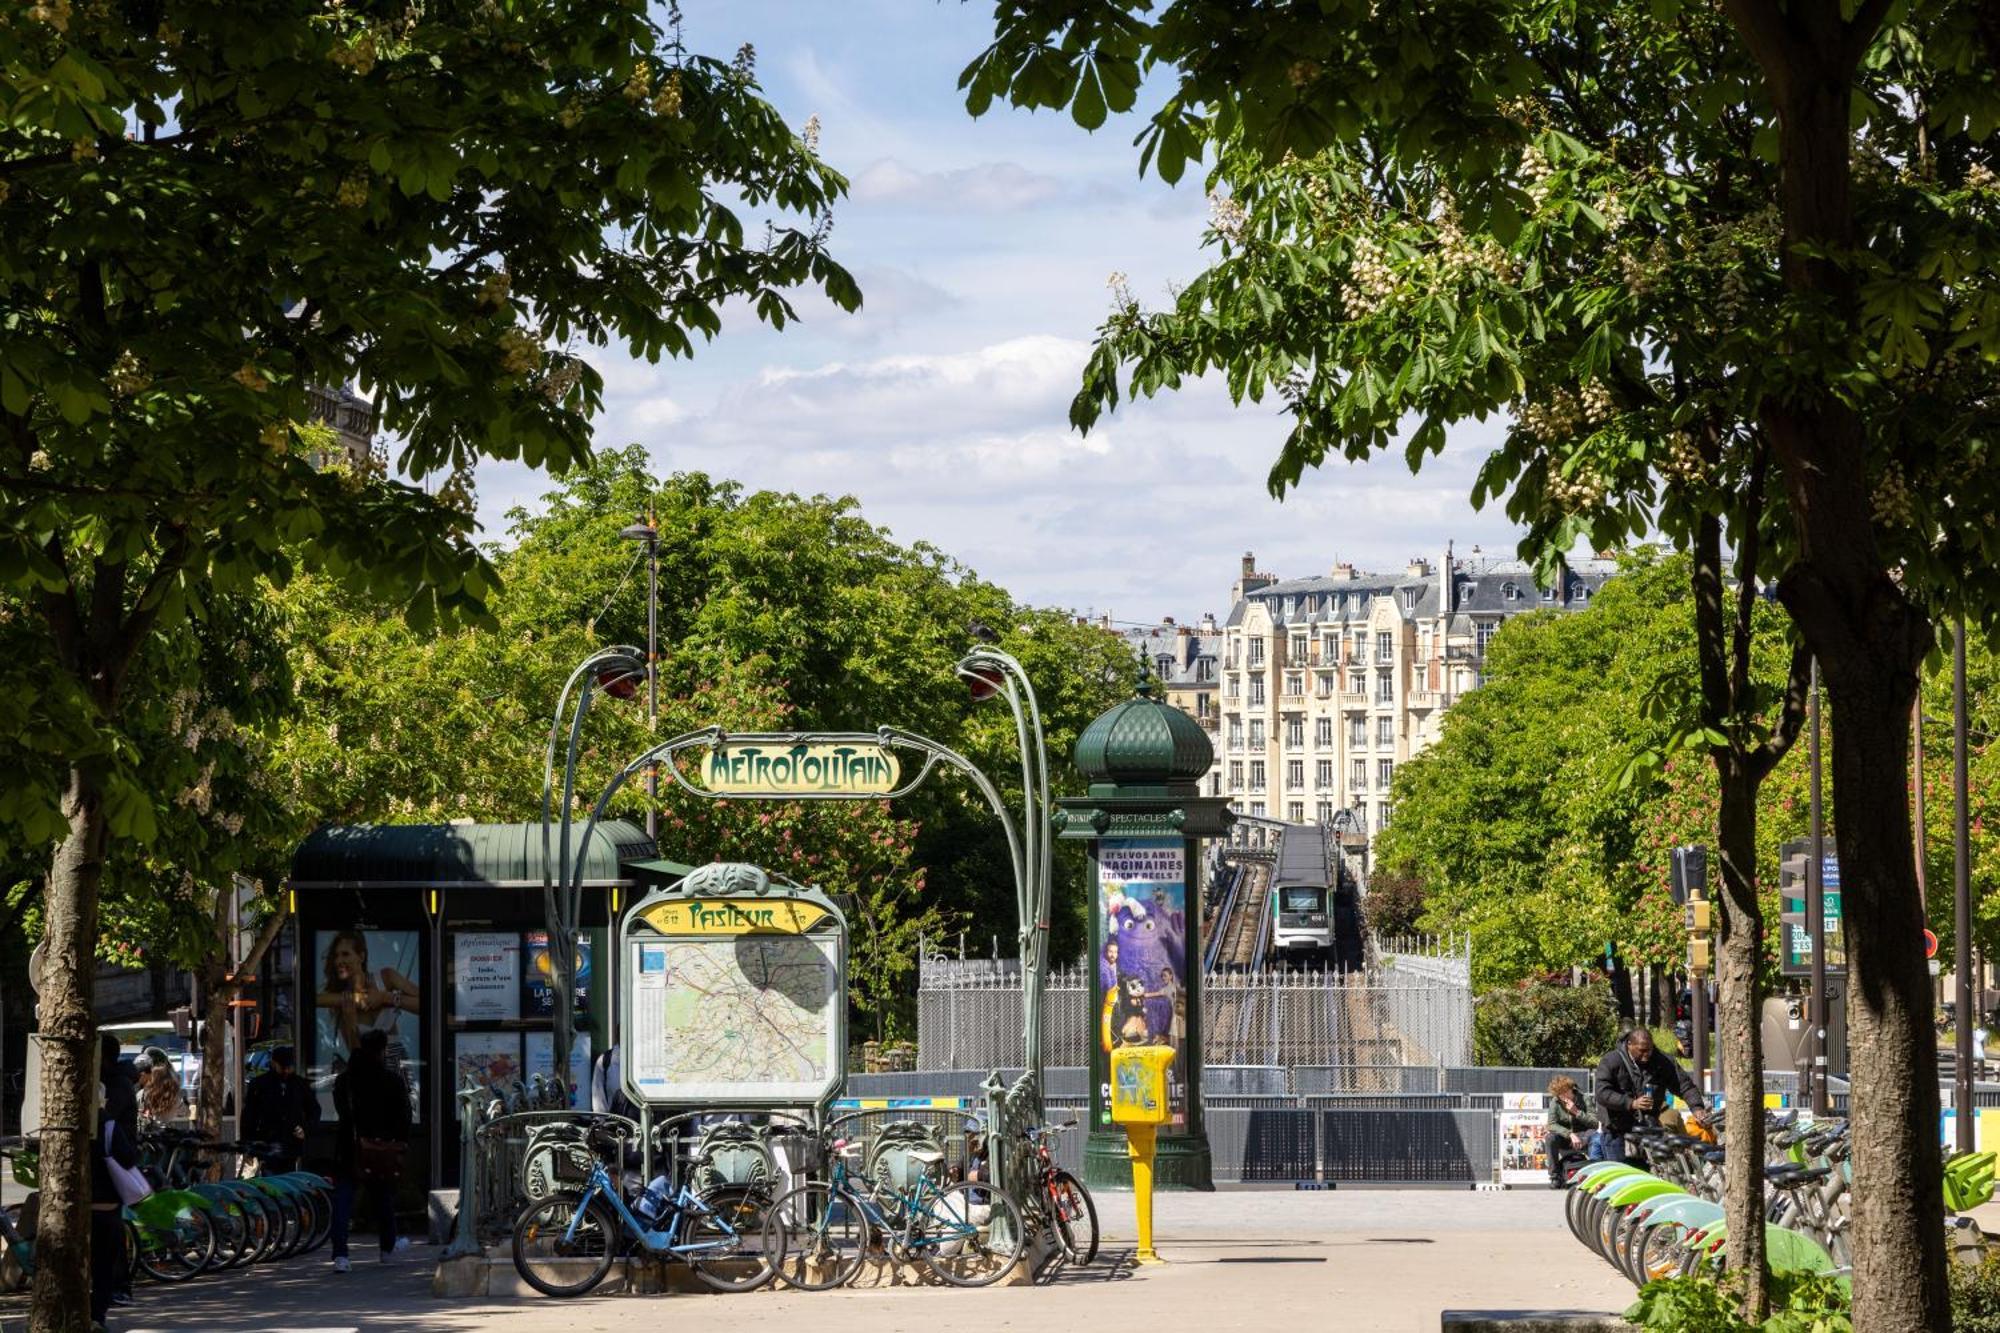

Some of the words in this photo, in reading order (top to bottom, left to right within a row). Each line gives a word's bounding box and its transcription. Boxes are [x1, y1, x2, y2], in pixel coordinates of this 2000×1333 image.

[710, 744, 892, 790] METROPOLITAIN
[1110, 814, 1167, 823] SPECTACLES
[1117, 851, 1126, 859] SI
[1128, 851, 1149, 859] VOS
[1151, 851, 1176, 859] AMIS
[1101, 860, 1183, 870] IMAGINAIRES
[687, 901, 776, 931] PASTEUR
